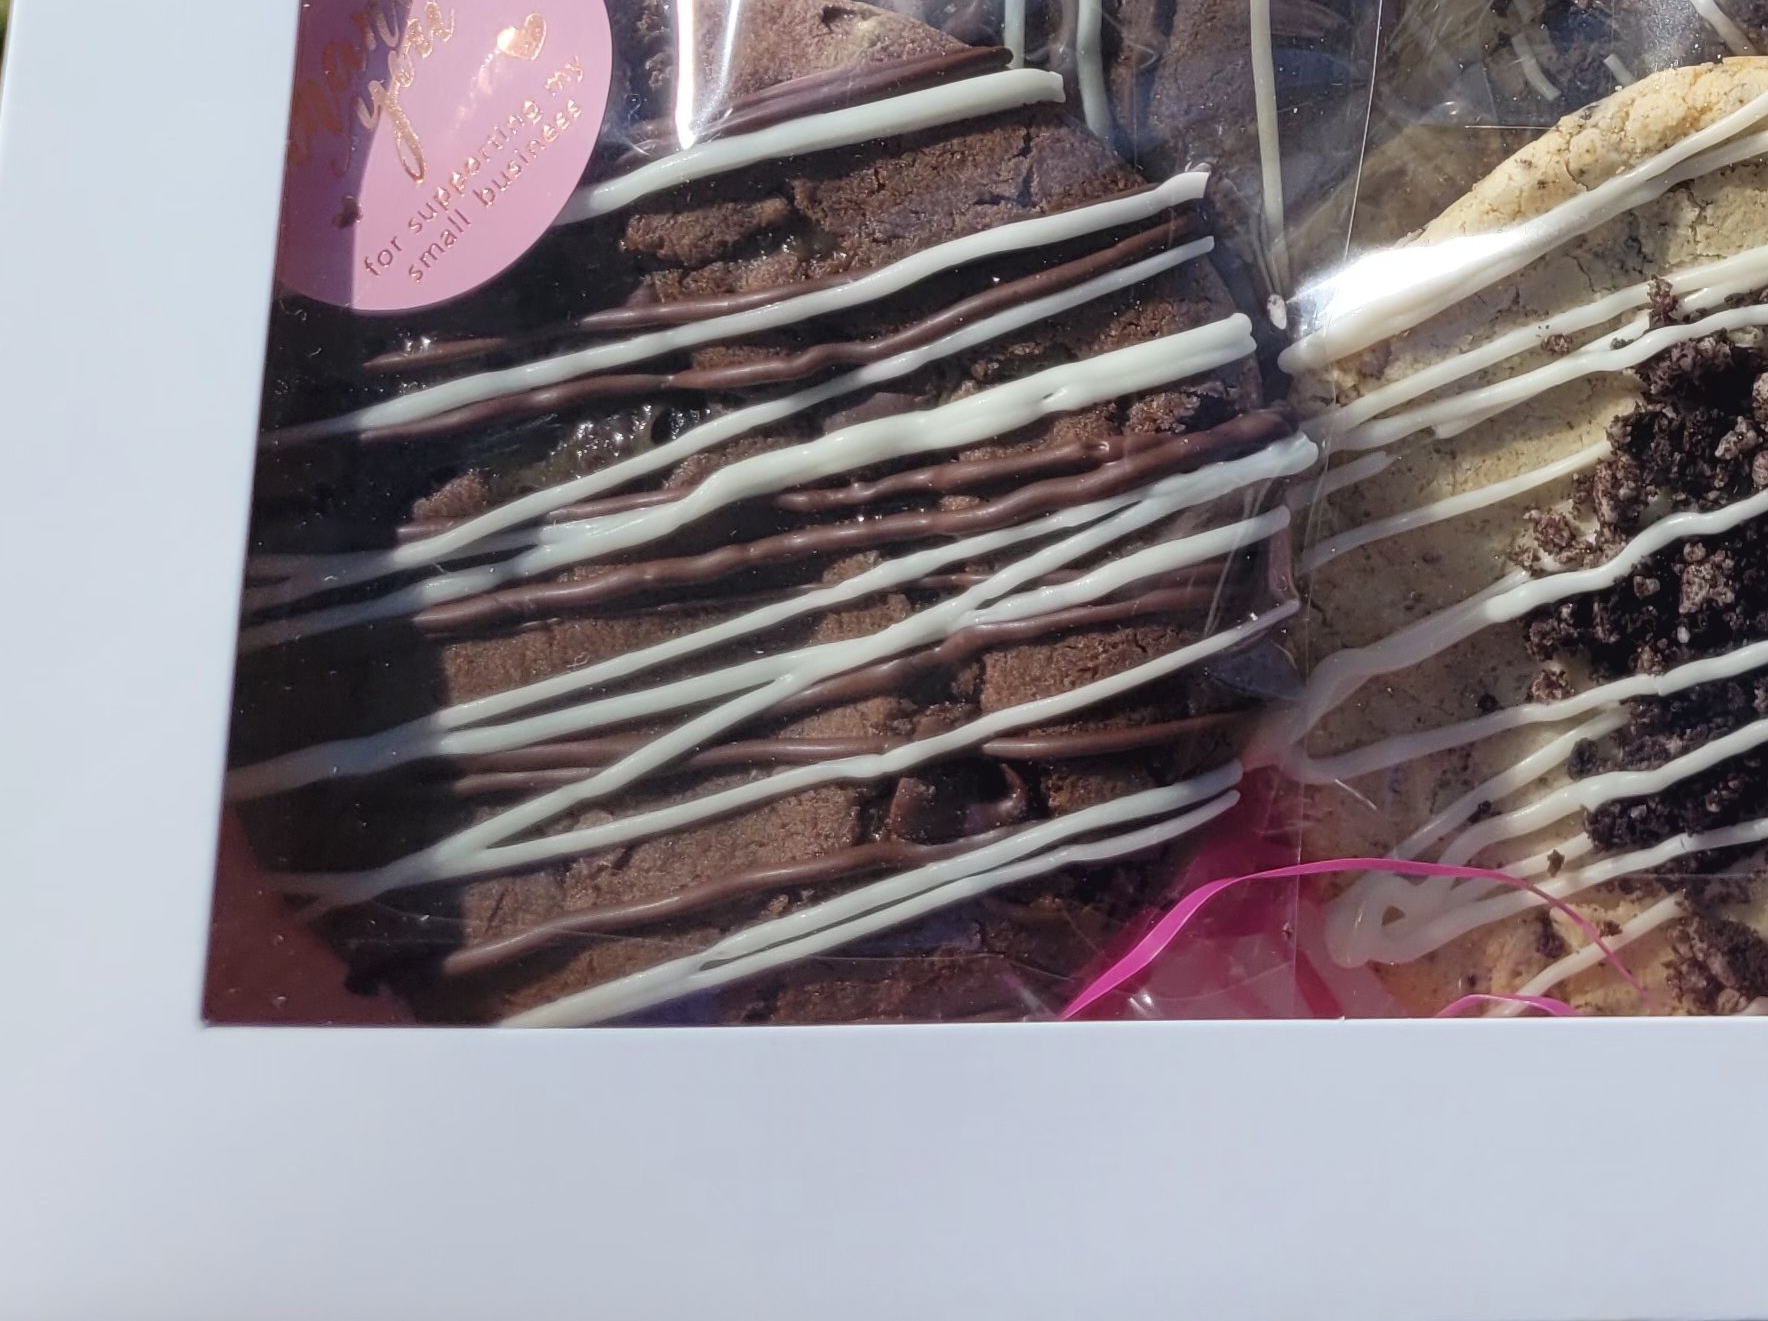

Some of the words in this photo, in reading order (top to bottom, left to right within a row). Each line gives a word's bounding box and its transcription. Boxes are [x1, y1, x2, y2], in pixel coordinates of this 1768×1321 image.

[363, 234, 403, 277] for
[407, 99, 540, 235] supporting
[545, 56, 584, 97] my
[408, 209, 471, 284] small
[474, 99, 581, 209] business
